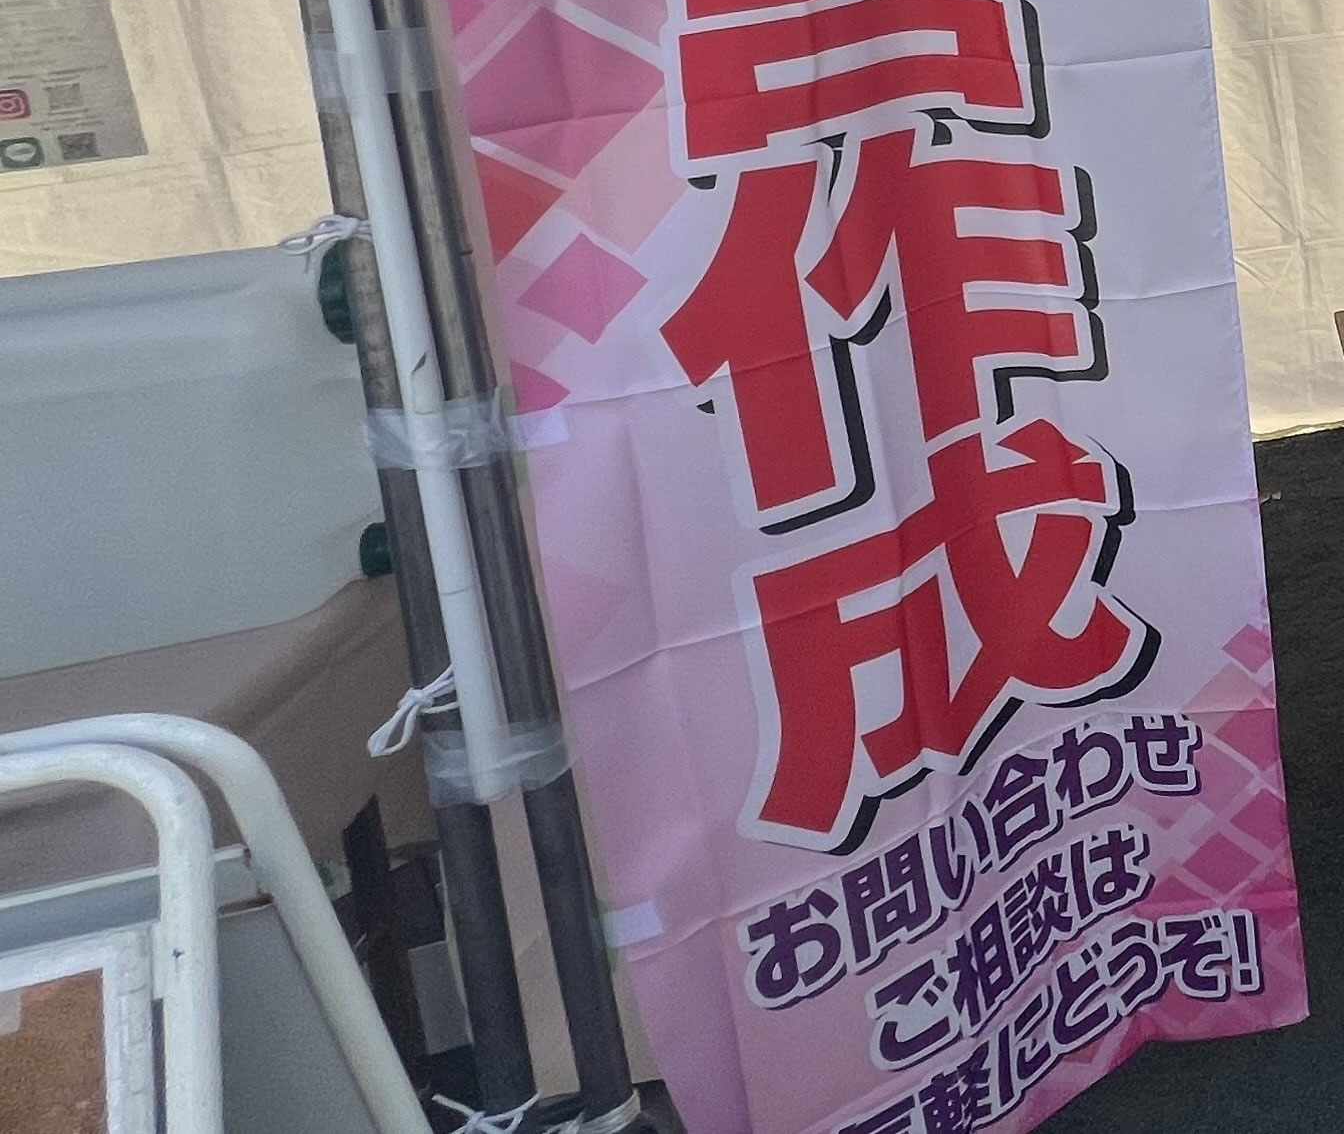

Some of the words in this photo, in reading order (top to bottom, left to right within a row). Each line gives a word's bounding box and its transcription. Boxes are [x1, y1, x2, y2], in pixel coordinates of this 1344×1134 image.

[744, 714, 1201, 1007] お問い合わせ
[868, 824, 1152, 1070] ご相談は
